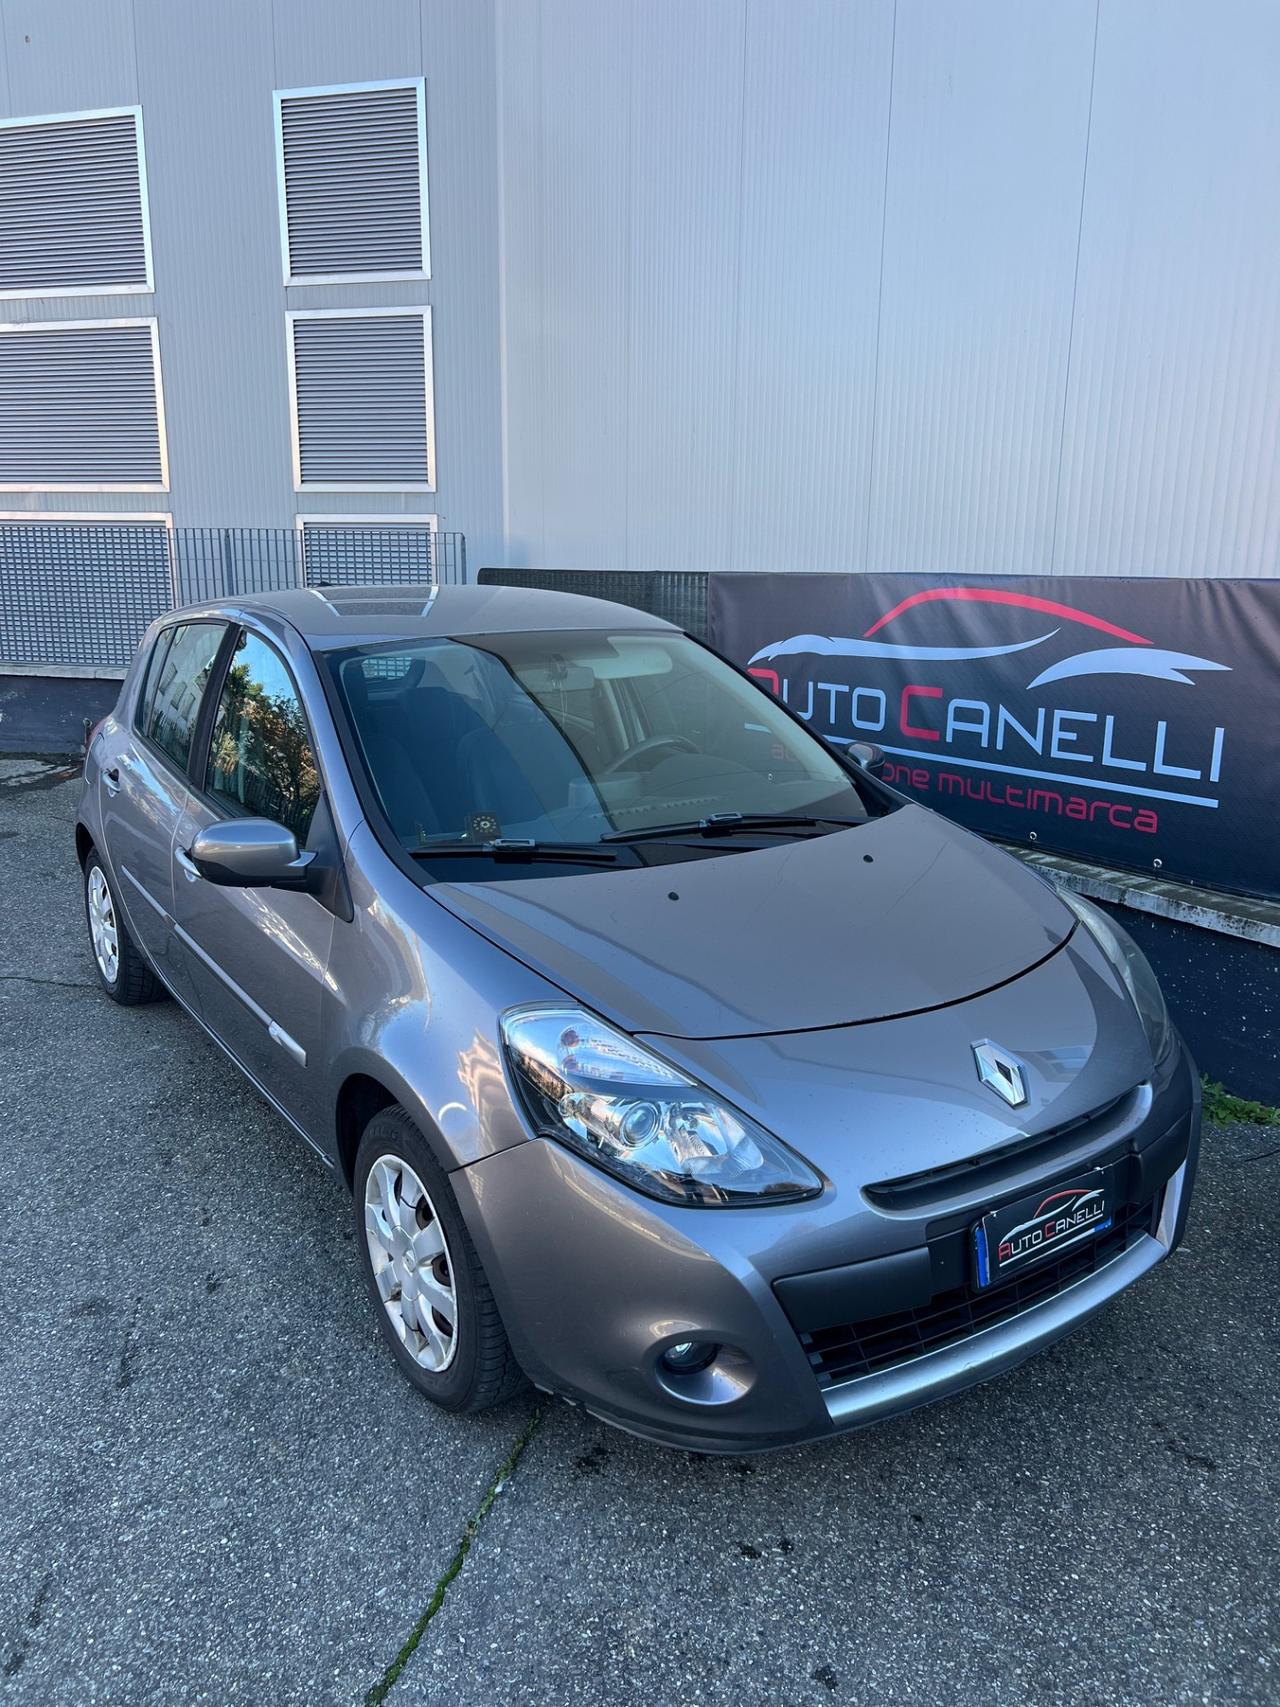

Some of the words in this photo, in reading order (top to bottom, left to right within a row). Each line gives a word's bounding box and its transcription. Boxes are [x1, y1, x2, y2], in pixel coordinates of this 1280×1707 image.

[900, 684, 1225, 782] CANELLI
[938, 772, 1158, 834] multimarca
[998, 1231, 1043, 1261] AUTO
[1044, 1200, 1105, 1237] CANELLI
